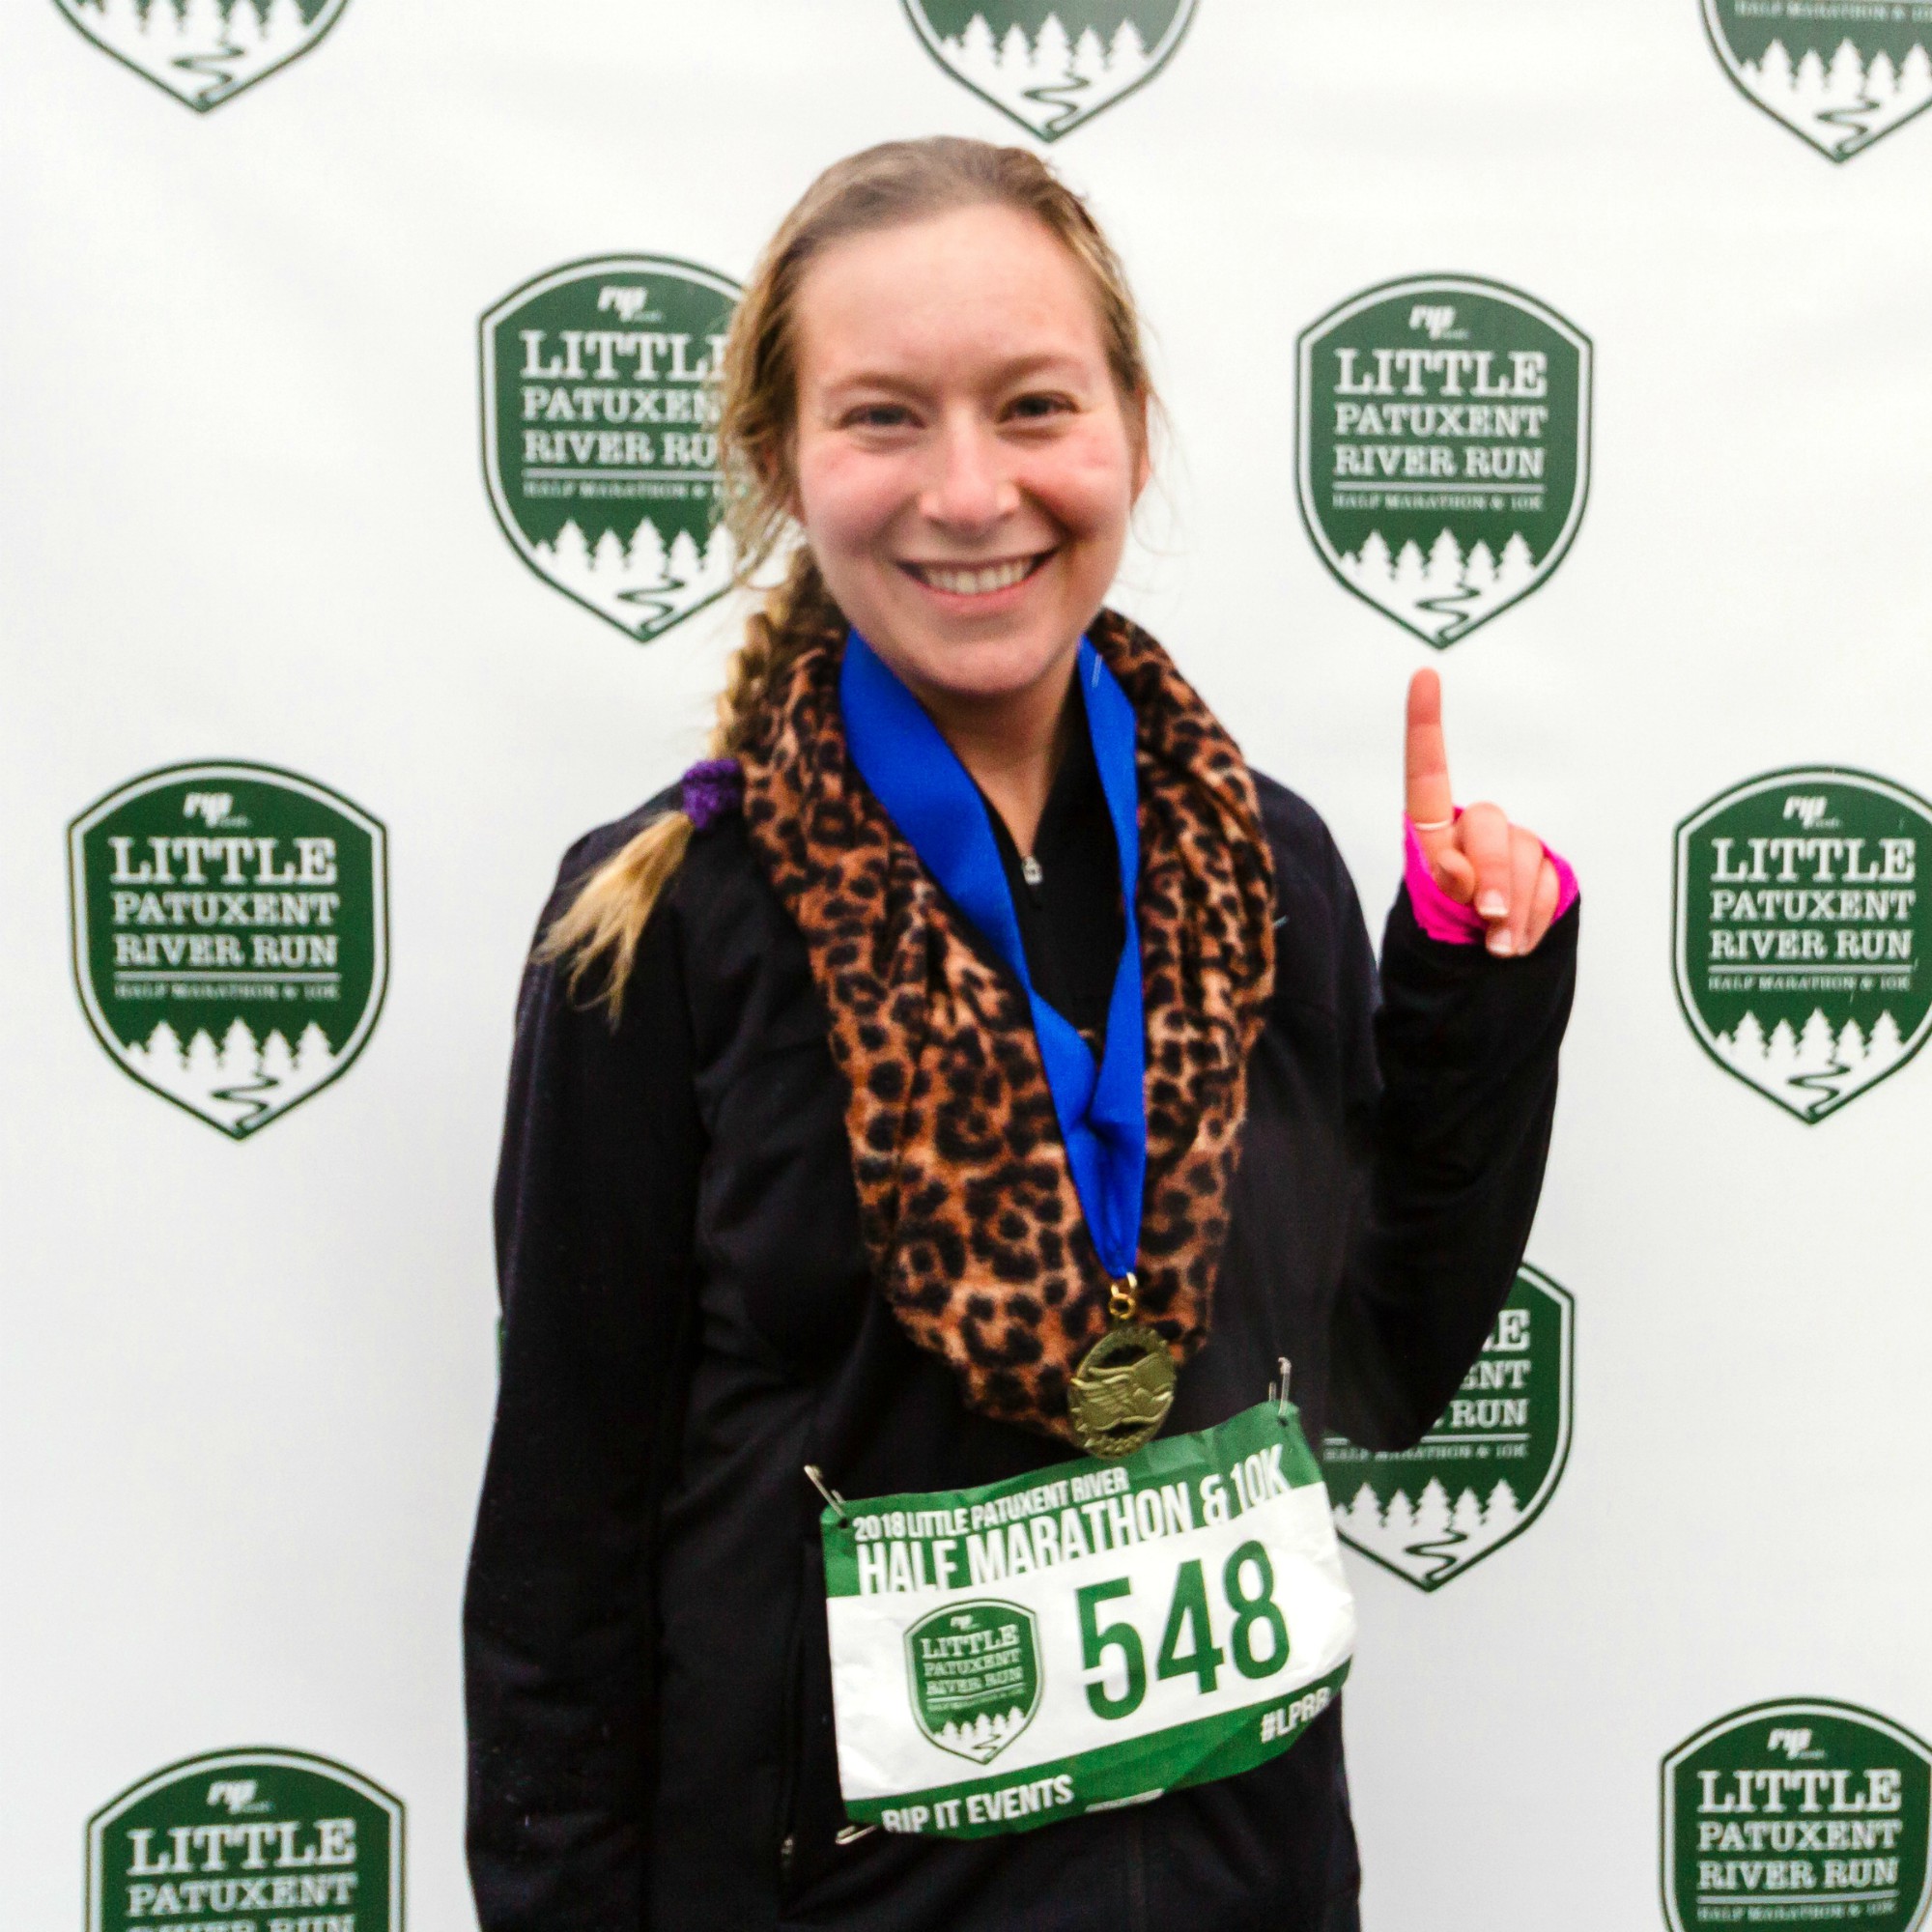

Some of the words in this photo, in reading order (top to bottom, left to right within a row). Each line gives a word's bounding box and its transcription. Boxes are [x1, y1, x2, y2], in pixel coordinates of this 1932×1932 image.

[1333, 348, 1548, 398] LITTLE
[522, 386, 723, 423] PATUXEN
[1334, 403, 1548, 438] PATUXENT
[523, 429, 655, 466] RIVER
[661, 433, 718, 467] RU
[1333, 444, 1457, 476] RIVER
[1463, 446, 1544, 478] RUN
[108, 836, 337, 885] LITTLE
[1710, 838, 1916, 883] LITTLE
[110, 892, 340, 925] PATUXENT
[1710, 889, 1917, 921] PATUXENT
[114, 933, 245, 967] RIVER
[249, 934, 339, 967] RUN
[1709, 929, 1828, 960] RIVER
[1834, 929, 1913, 961] RUN
[1449, 1399, 1530, 1429] RUN
[853, 1512, 906, 1542] 2018
[906, 1508, 969, 1538] LITTLE
[970, 1480, 1069, 1531] PATUXENT
[1070, 1466, 1130, 1503] RIVER
[857, 1540, 958, 1595] HALF
[966, 1482, 1194, 1585] MARATHON
[1200, 1473, 1230, 1526] &
[1230, 1443, 1292, 1513] 10K
[921, 1624, 1020, 1659] LITTLE
[1076, 1539, 1290, 1720] 548
[923, 1647, 1022, 1677] PATUXENT
[881, 1805, 928, 1833] RIP
[934, 1799, 961, 1831] IT
[966, 1775, 1074, 1825] EVENTS
[1696, 1769, 1901, 1813] LITTLE
[126, 1818, 357, 1876] LITTLE
[1697, 1819, 1903, 1852] PATUXENT
[1696, 1860, 1817, 1889] RIVER
[1823, 1857, 1899, 1888] RUN
[125, 1871, 358, 1918] PATUXENT
